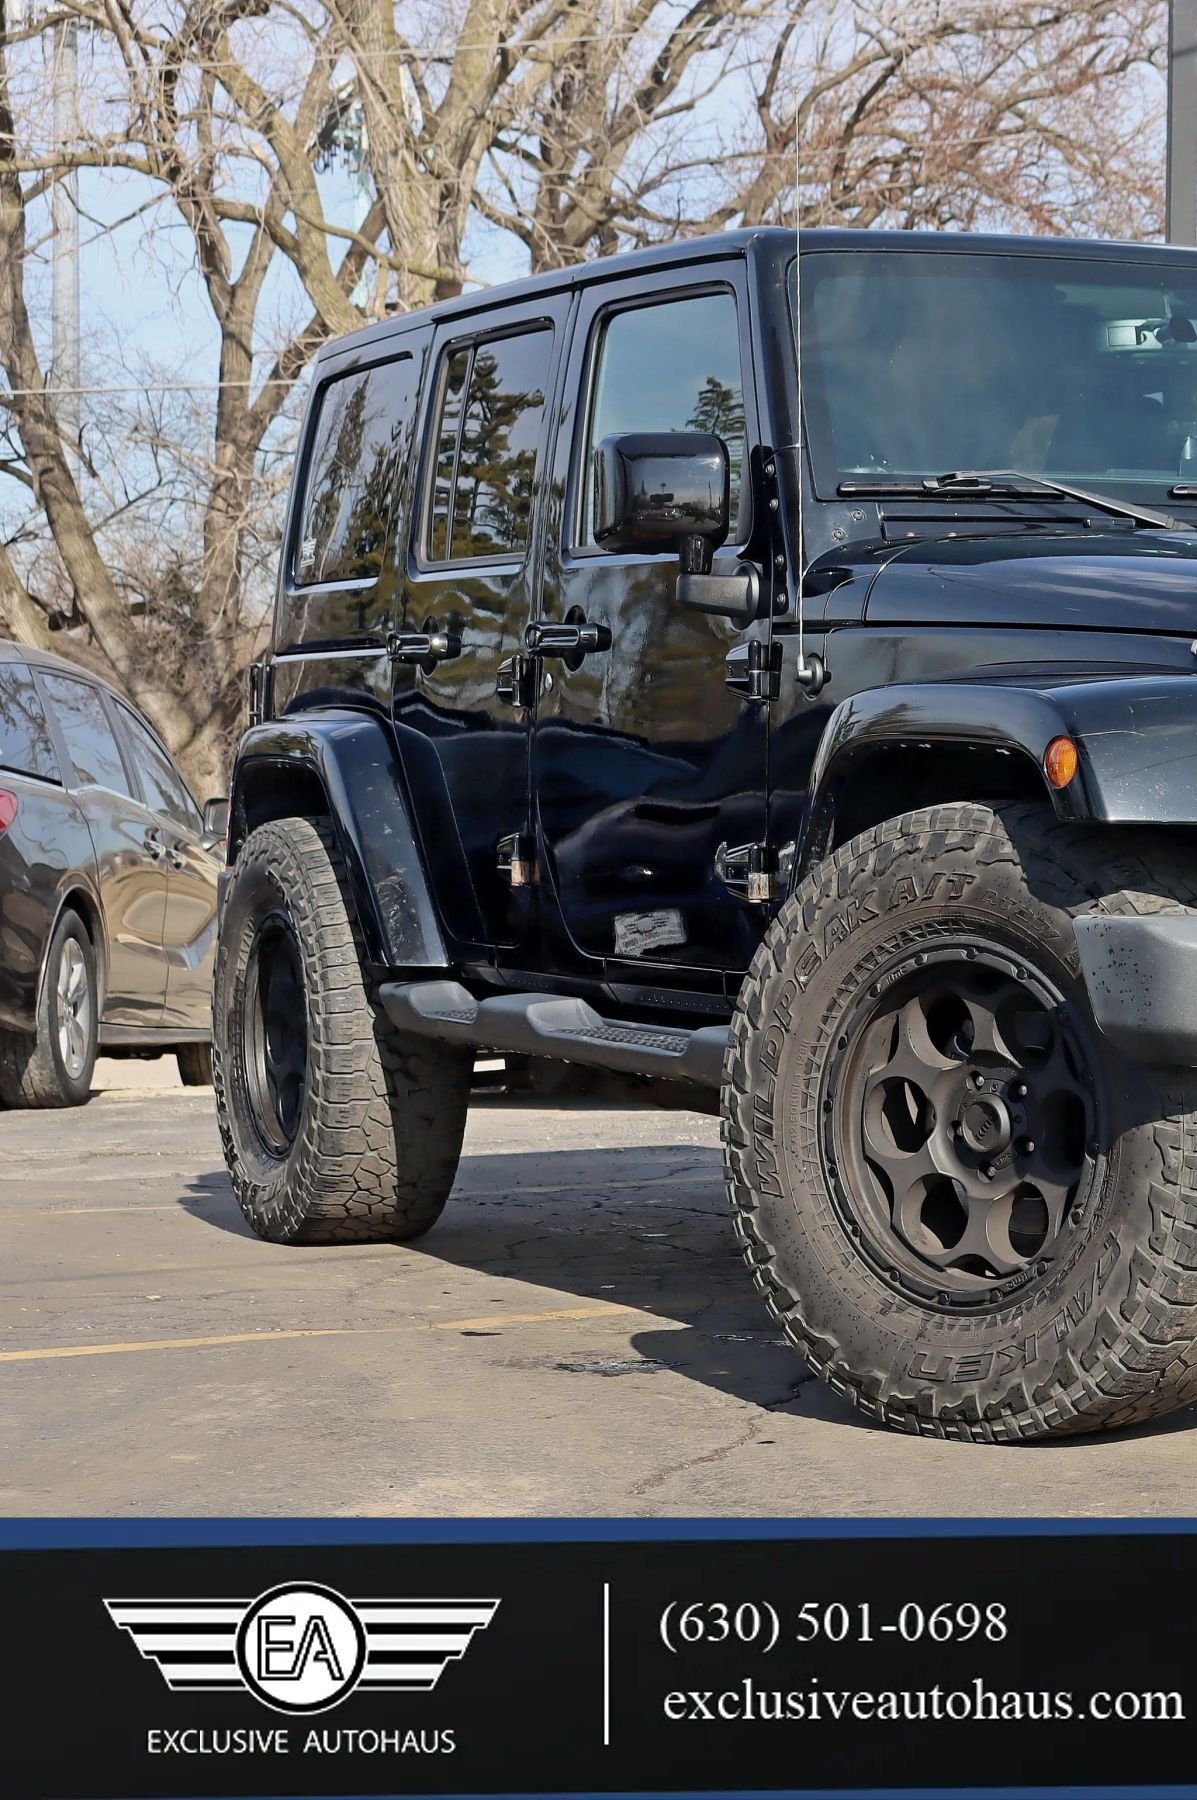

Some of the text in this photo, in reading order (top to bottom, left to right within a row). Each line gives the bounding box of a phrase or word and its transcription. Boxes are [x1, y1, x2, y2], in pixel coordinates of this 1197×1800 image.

[753, 889, 881, 1199] WILDPEAK
[888, 872, 978, 911] A/T
[907, 1229, 1122, 1384] FALKEN
